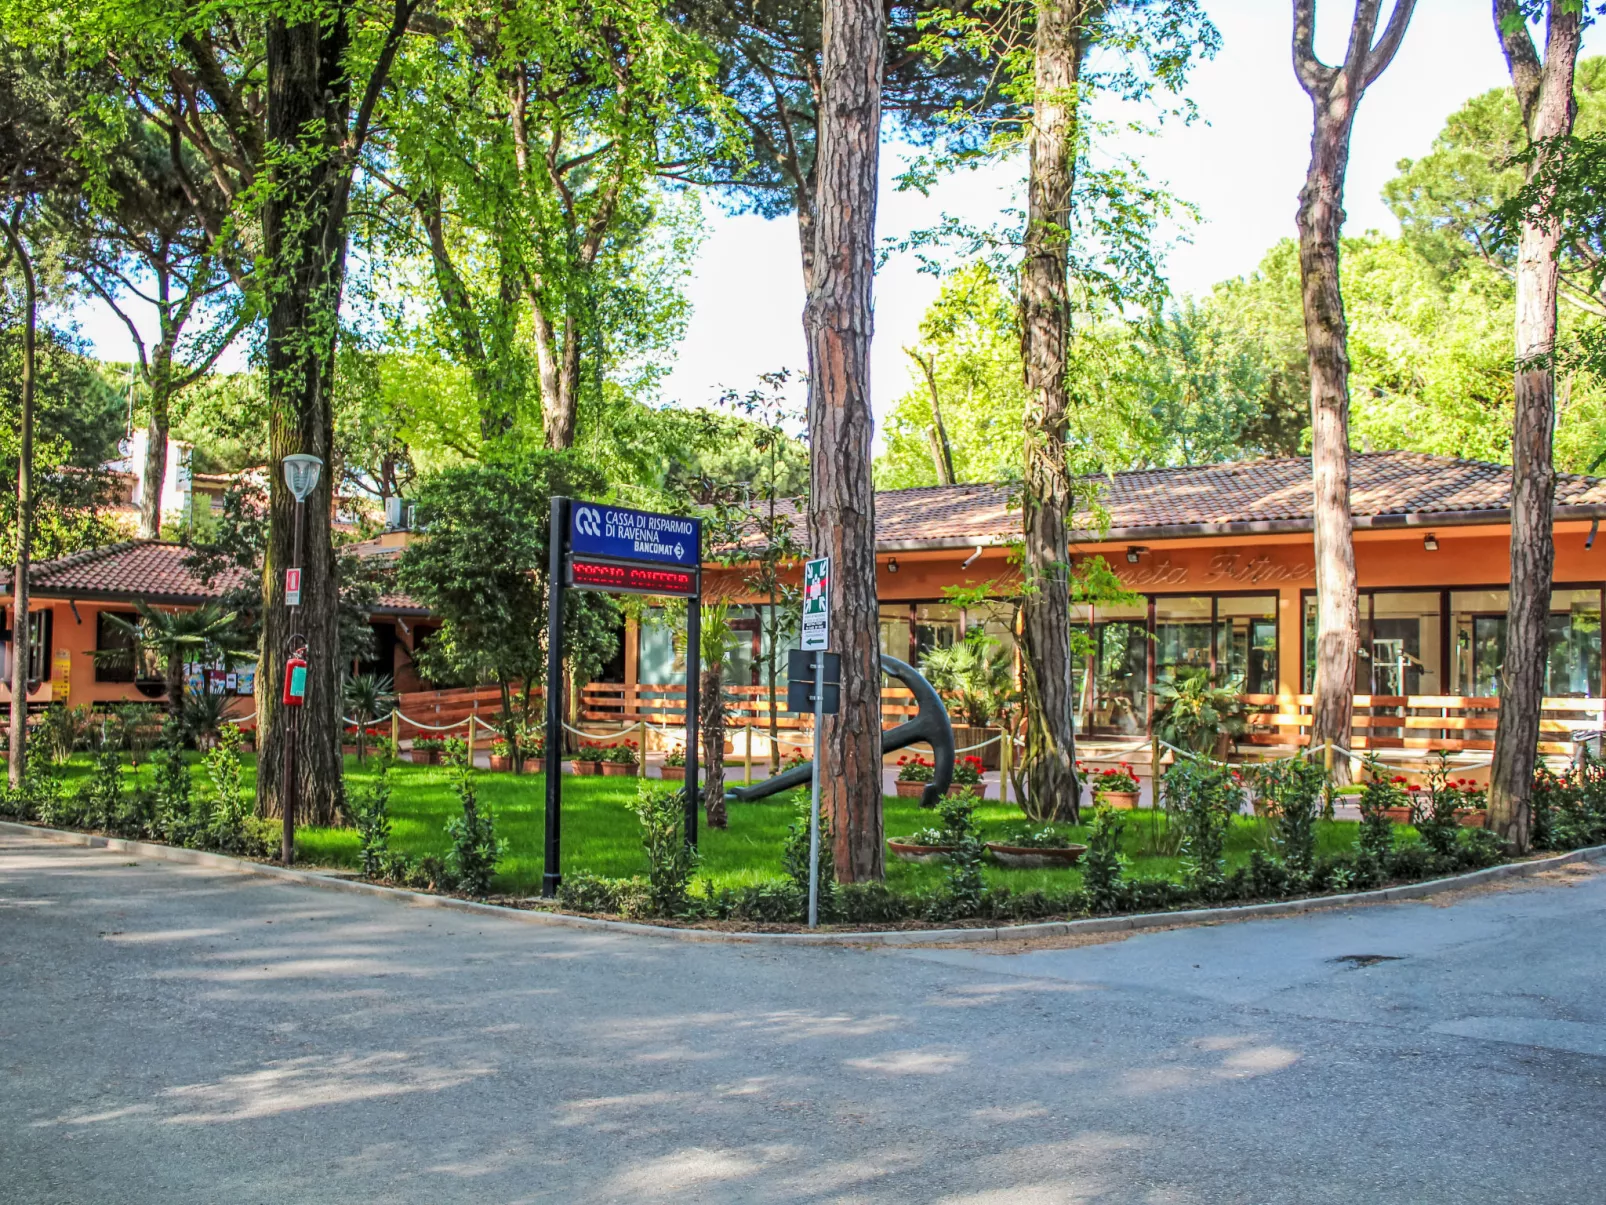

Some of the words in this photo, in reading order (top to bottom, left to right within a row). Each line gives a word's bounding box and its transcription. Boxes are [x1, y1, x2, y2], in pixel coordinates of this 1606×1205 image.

[606, 511, 634, 528] CASSA
[636, 515, 646, 529] DI
[649, 517, 693, 535] RISPARMIO
[606, 524, 616, 538] DI
[618, 527, 659, 543] RAVENNA
[634, 542, 673, 555] BANCOMAT
[1203, 554, 1316, 586] Fitne
